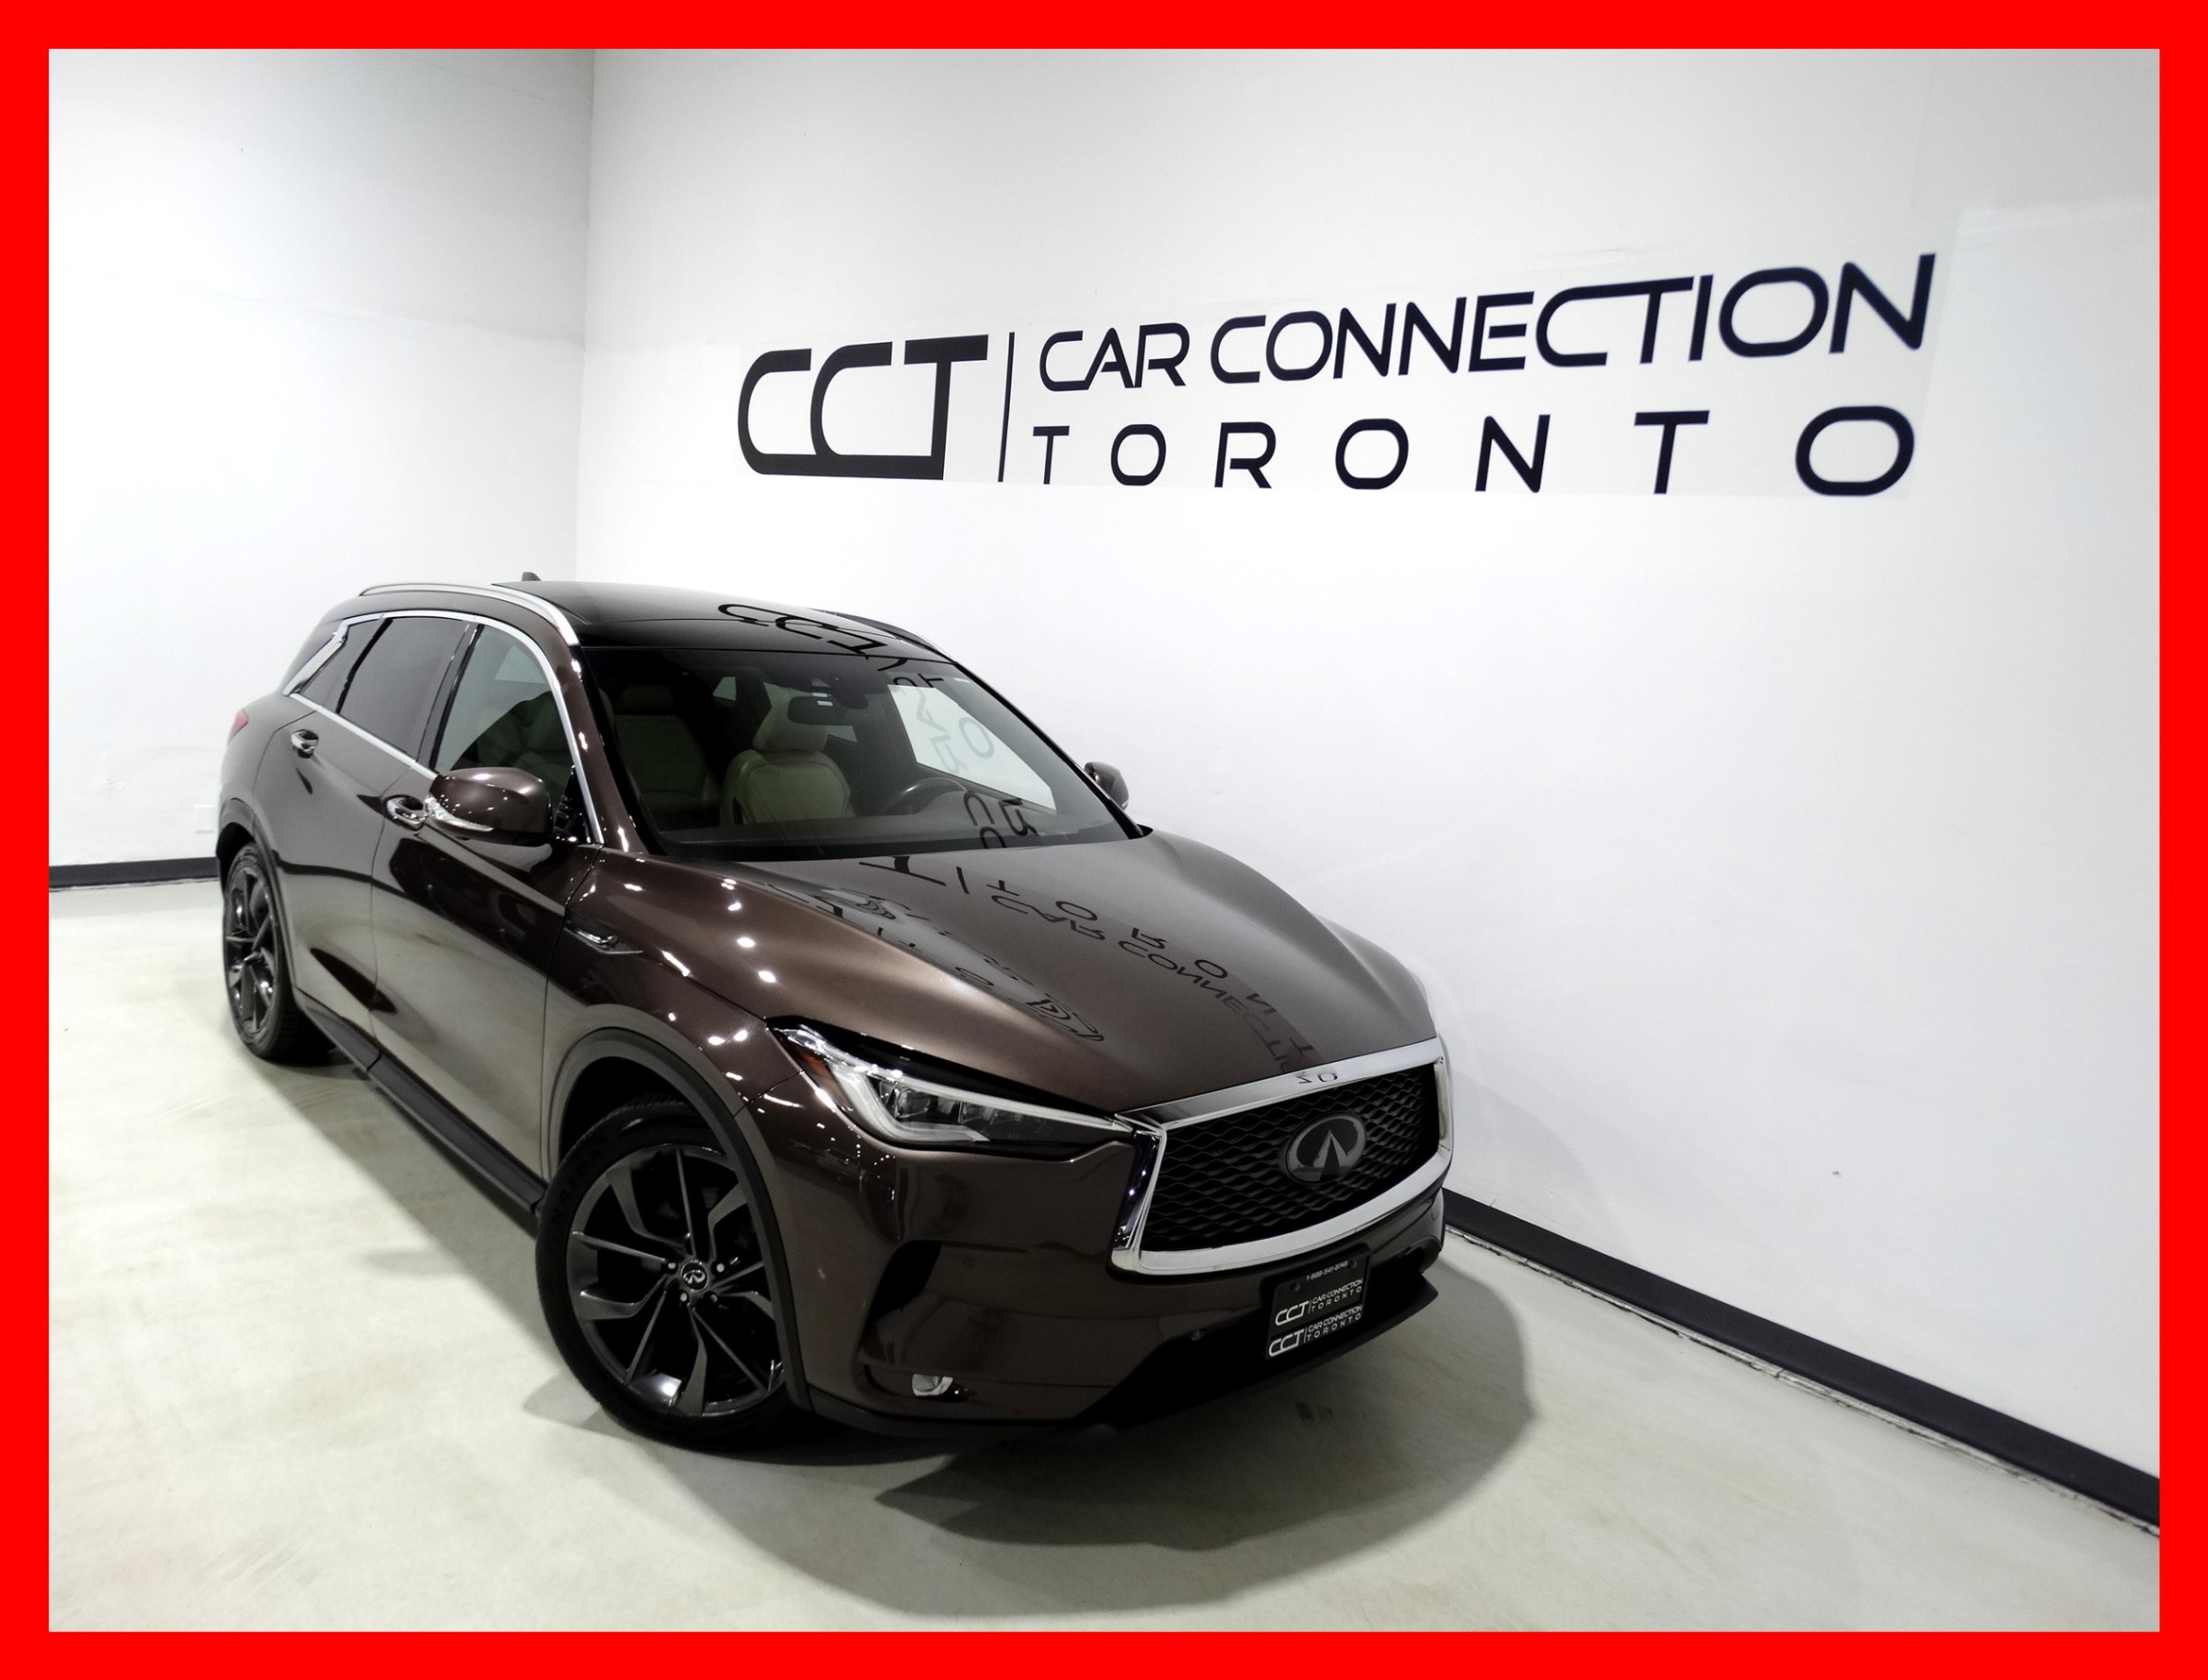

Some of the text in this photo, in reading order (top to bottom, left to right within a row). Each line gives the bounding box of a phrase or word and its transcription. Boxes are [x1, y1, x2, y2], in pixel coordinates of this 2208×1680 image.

[1039, 254, 1935, 392] CAR CONNECTION
[738, 334, 989, 481] CCT
[1033, 405, 1915, 496] TORONTO
[1311, 1286, 1363, 1312] TORONTO
[1312, 1278, 1363, 1305] CAR CONNECTION
[1275, 1300, 1309, 1326] CCT
[1308, 1304, 1363, 1333] CAR CONNECTION
[1269, 1328, 1305, 1357] CCT
[1307, 1313, 1362, 1343] TORONTO
